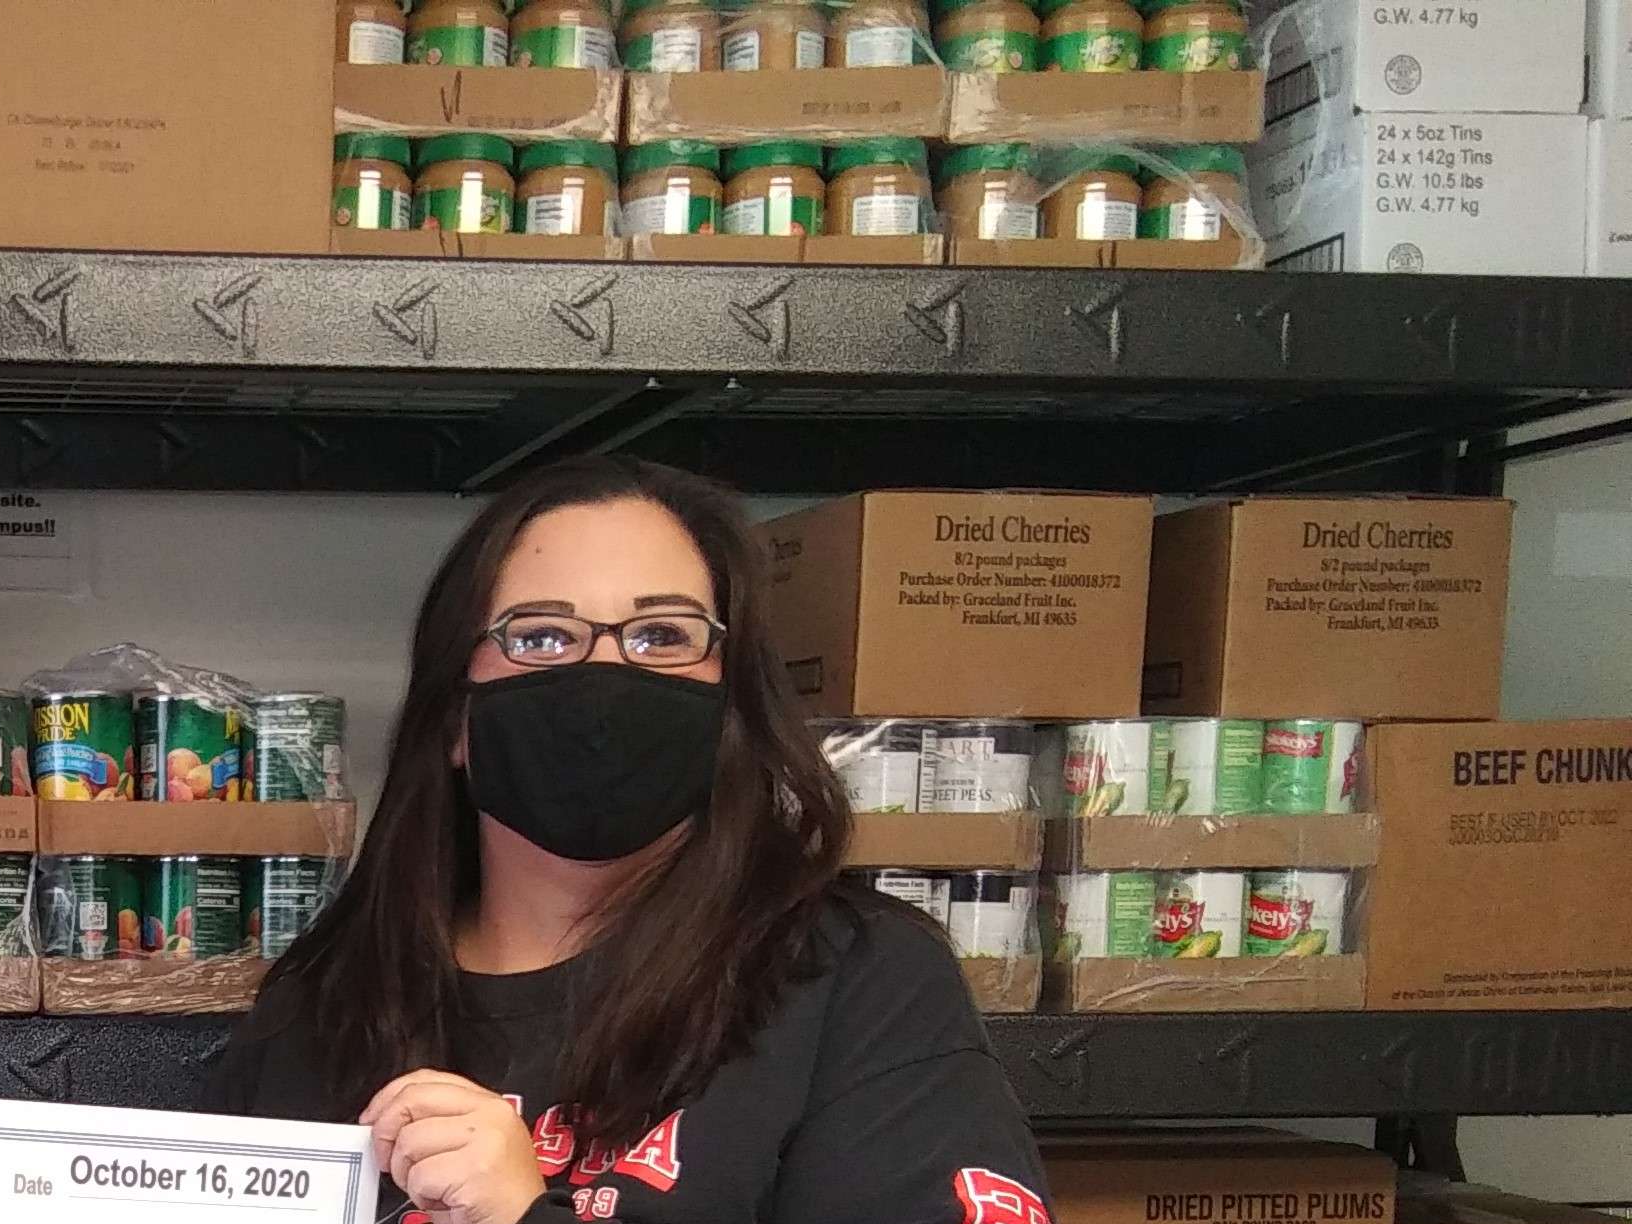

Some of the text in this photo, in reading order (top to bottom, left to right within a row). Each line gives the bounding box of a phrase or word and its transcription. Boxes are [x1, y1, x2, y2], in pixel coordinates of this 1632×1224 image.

[1373, 8, 1478, 28] G.W. 4.77 kg
[1377, 125, 1482, 141] 24 x 5oz Tins
[1377, 149, 1493, 169] 24 x 142g Tins
[1376, 173, 1483, 189] G.W. 10.5 lbs
[1376, 196, 1479, 217] G.W. 4.77 kg
[0, 493, 41, 508] site.
[935, 515, 1091, 545] Dried Cherries
[1303, 522, 1454, 550] Dried Cherries
[955, 552, 1066, 571] 8/2 pound packages
[1342, 558, 1378, 576] pound
[1381, 559, 1430, 576] packages
[900, 572, 954, 587] Purchase
[956, 572, 992, 587] Order
[994, 573, 1046, 588] Number:
[899, 591, 940, 605] Packed
[963, 592, 1022, 607] Graceland
[1024, 593, 1053, 608] Fruit
[1056, 594, 1077, 608] Inc.
[1023, 611, 1040, 626] MI
[1454, 750, 1527, 786] BEEF
[13, 1154, 310, 1199] Date October 16, 2020
[1146, 1192, 1385, 1221] DRIED PITTED PLUMS
